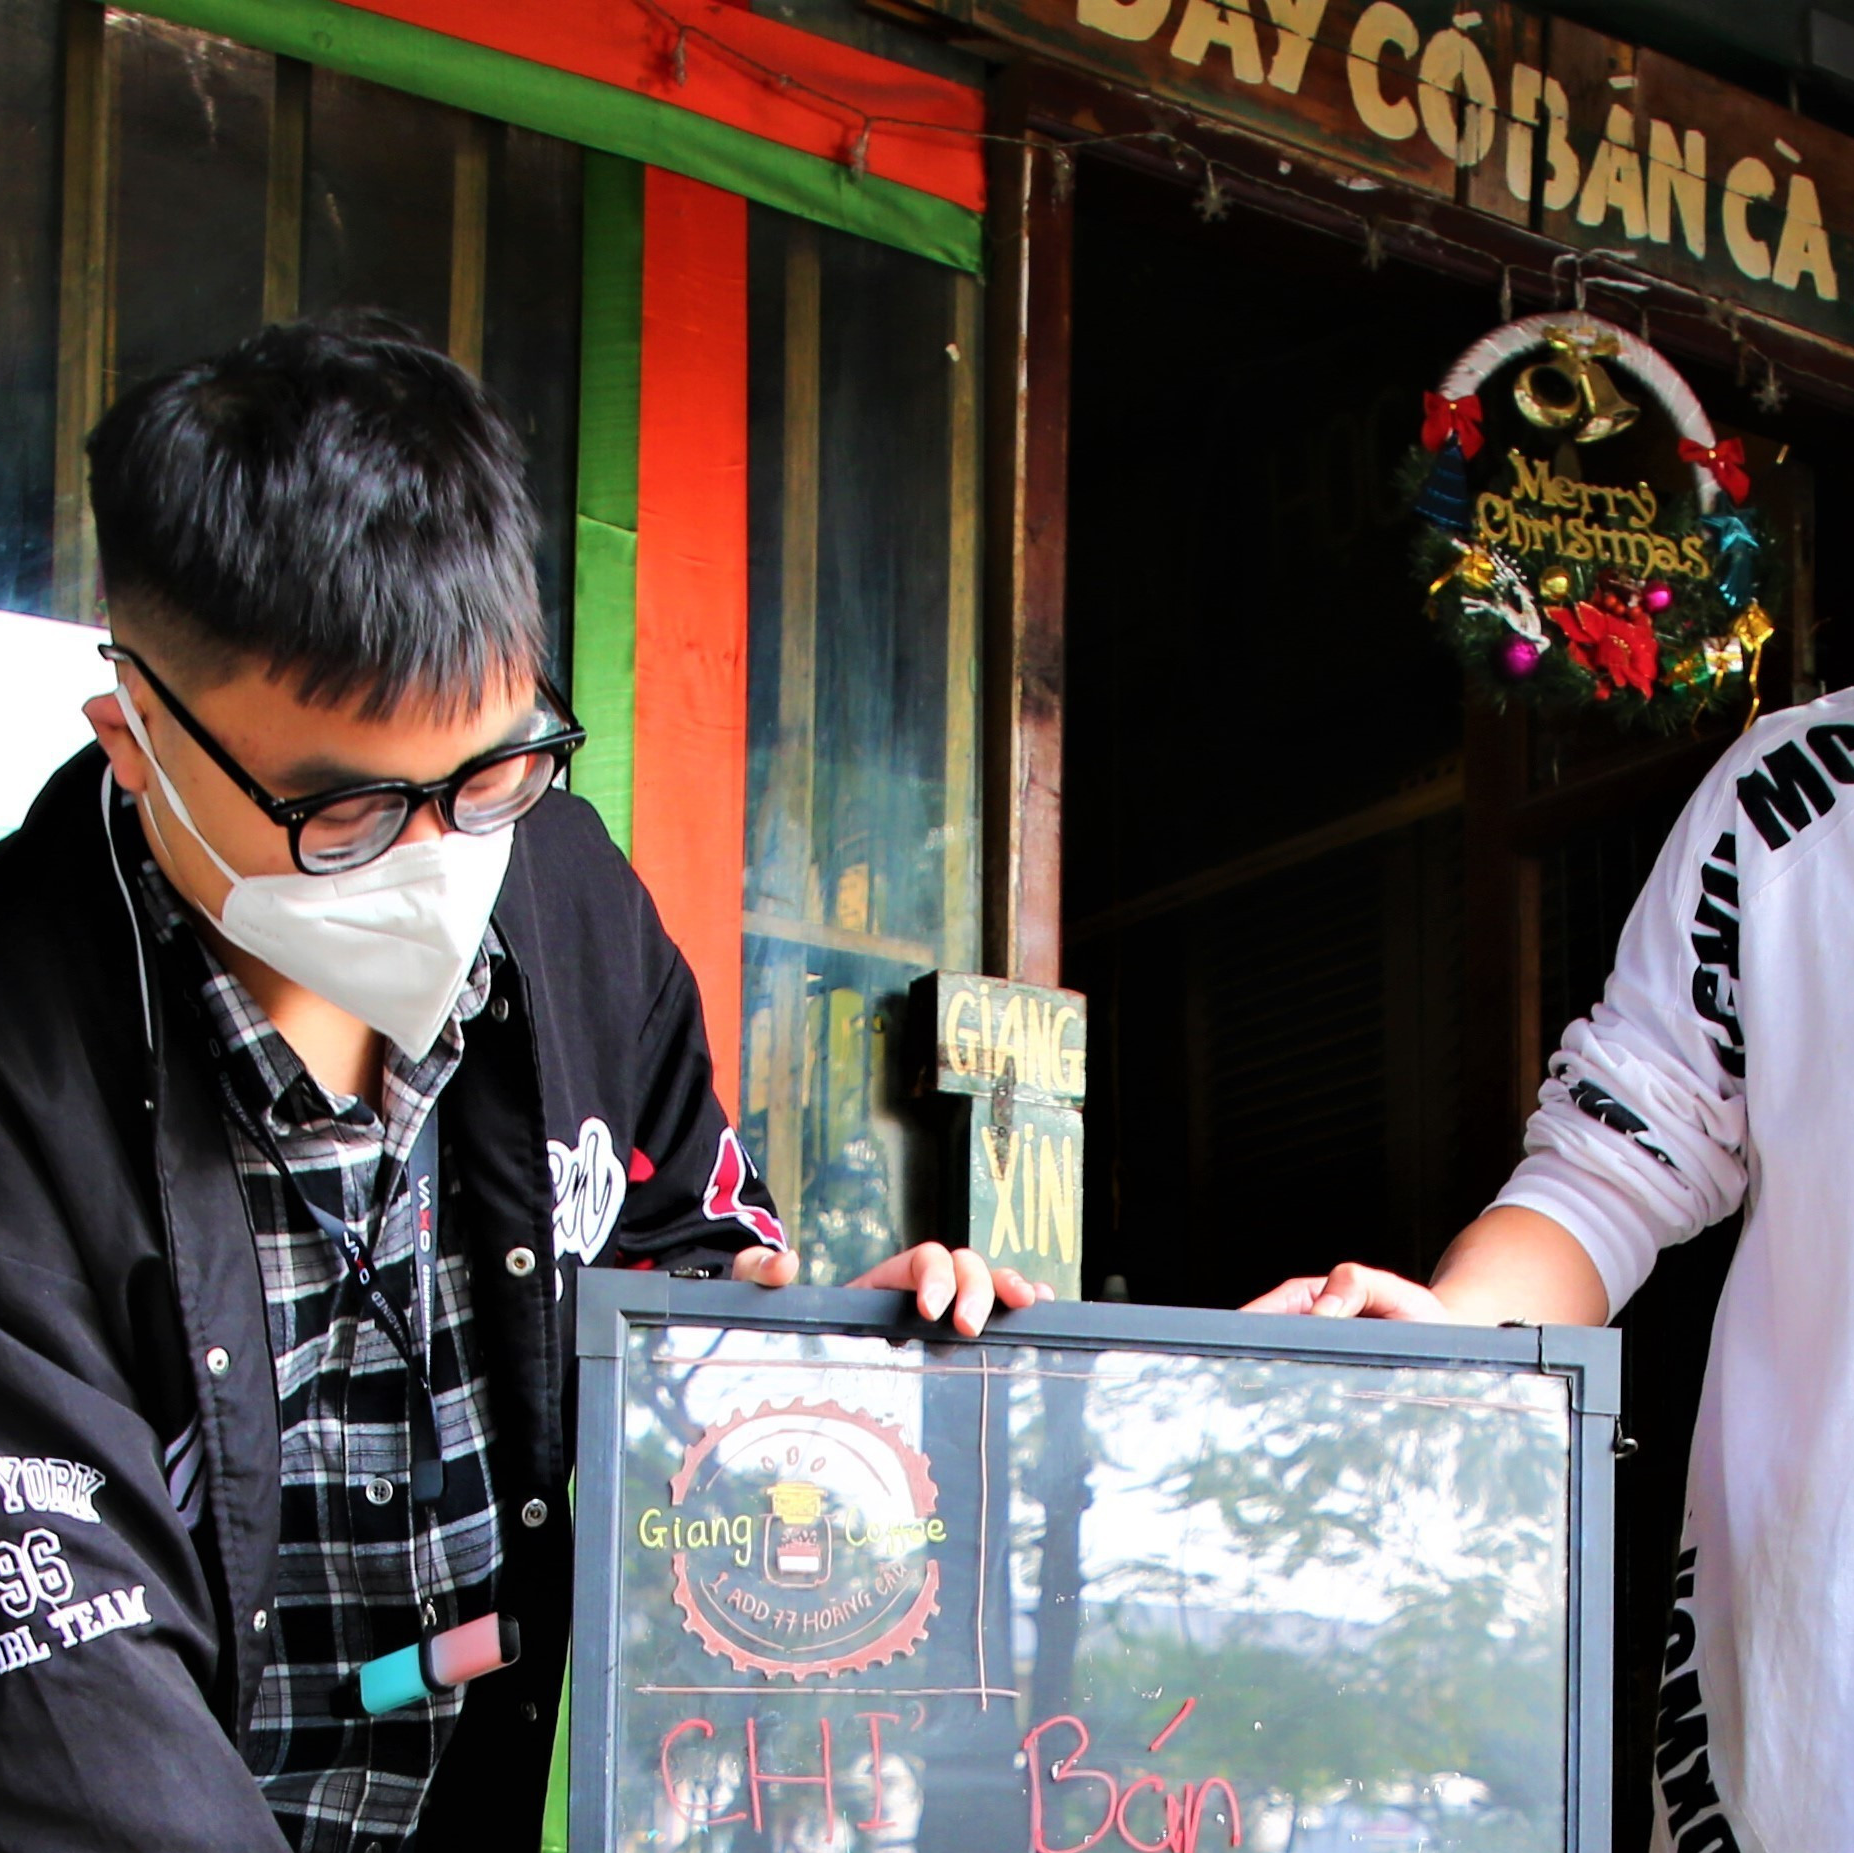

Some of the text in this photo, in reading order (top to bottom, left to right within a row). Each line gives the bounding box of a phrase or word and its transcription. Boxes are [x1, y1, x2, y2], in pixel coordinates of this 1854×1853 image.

[1506, 75, 1706, 260] BÁN
[1722, 138, 1839, 301] CÀ
[1508, 448, 1657, 529] Merry
[1477, 492, 1710, 580] Christmas
[638, 1508, 753, 1568] Giang
[47, 1585, 152, 1649] TEAM
[726, 1587, 770, 1623] ADD
